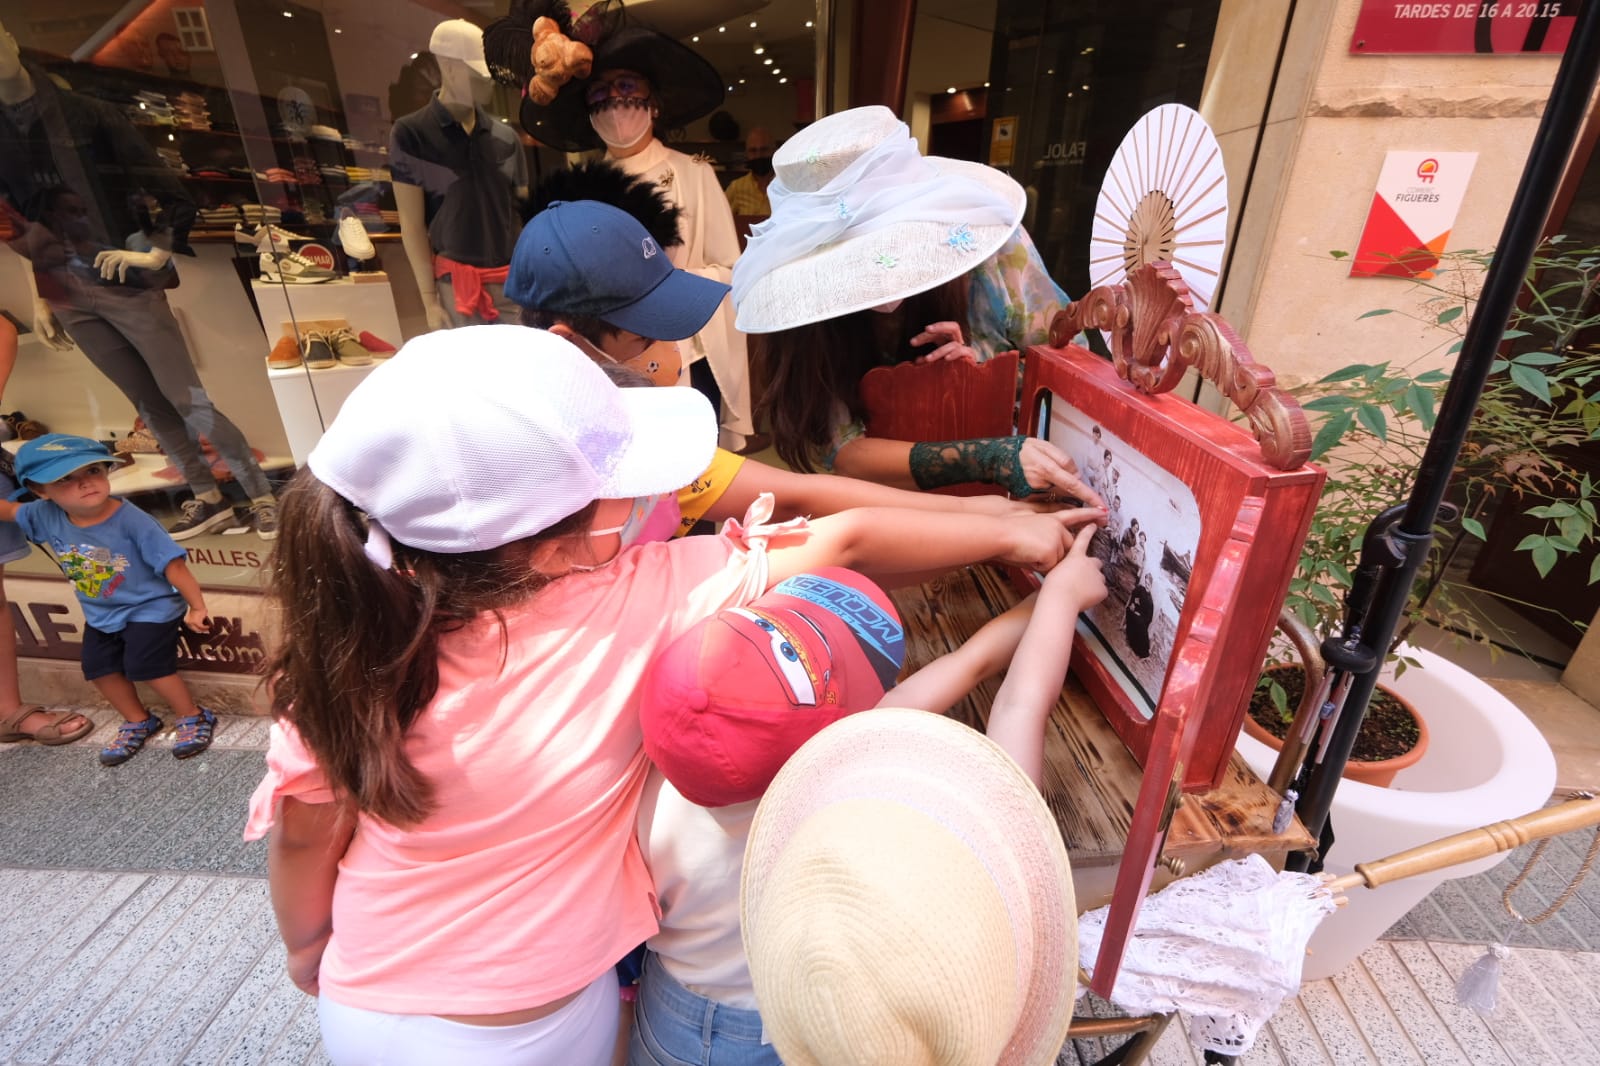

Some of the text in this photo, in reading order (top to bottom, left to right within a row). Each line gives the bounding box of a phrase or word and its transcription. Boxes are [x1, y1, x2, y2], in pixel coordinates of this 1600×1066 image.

[1394, 3, 1562, 18] TARDES DE 16 A 20.15
[1395, 193, 1440, 203] FIGUERES
[185, 548, 261, 568] TALLES
[785, 576, 904, 644] MCQUEEN
